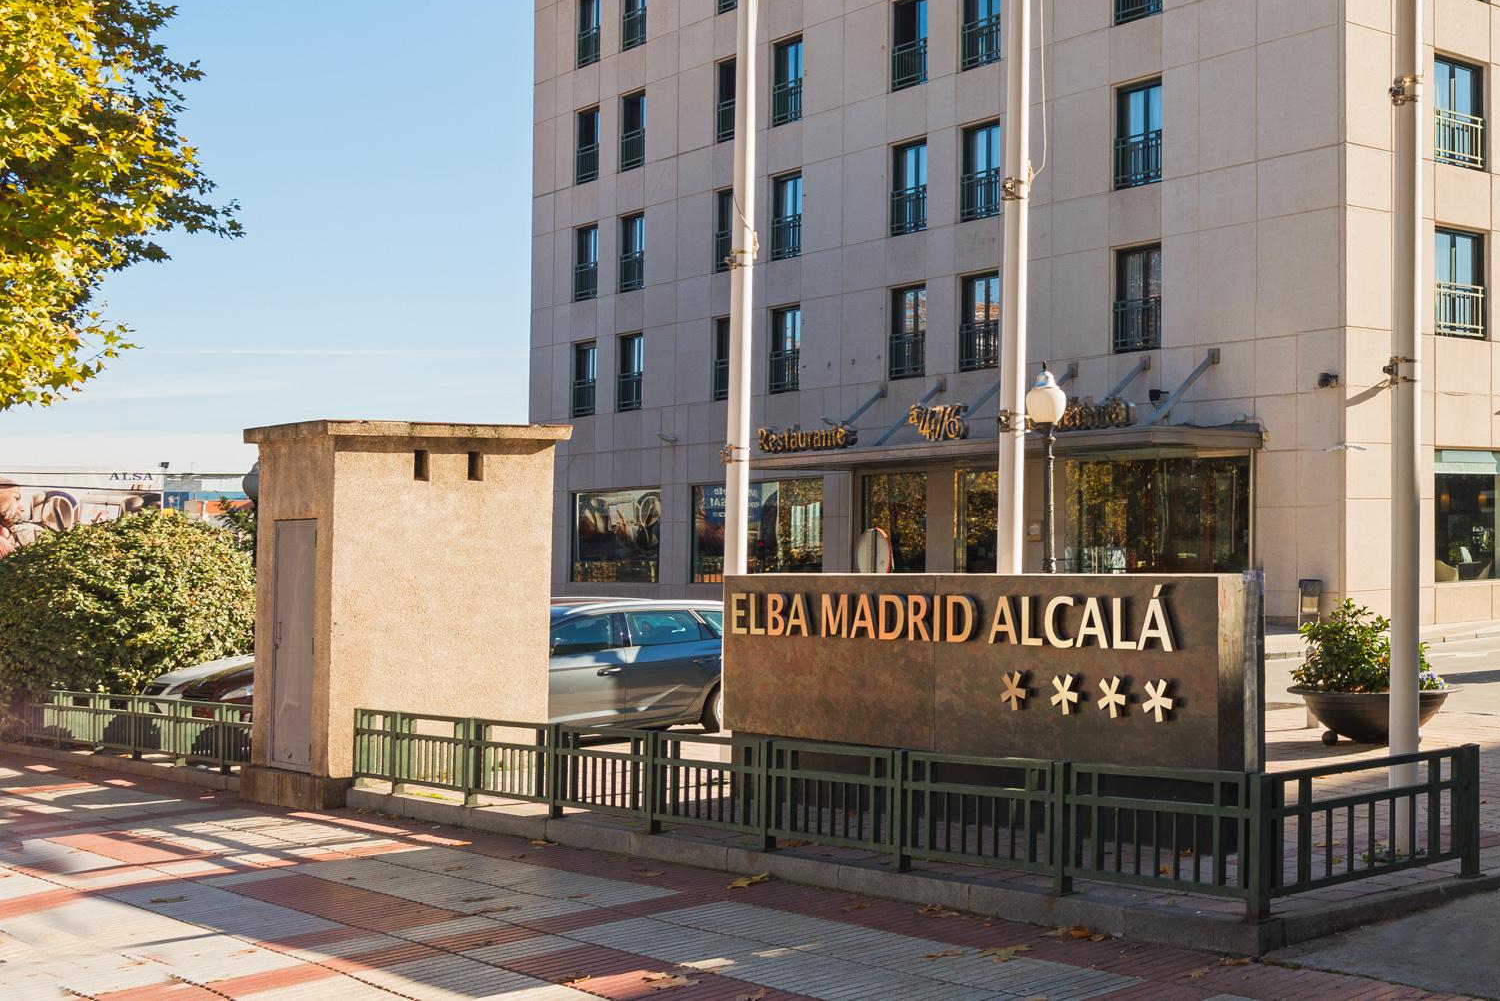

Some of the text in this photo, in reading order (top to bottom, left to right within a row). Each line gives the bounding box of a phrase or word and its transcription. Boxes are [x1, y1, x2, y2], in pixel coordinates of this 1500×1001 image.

[757, 424, 848, 454] Restaurante
[109, 472, 153, 481] ALSA
[731, 584, 1174, 652] ELBA MADRID ALCALÁ
